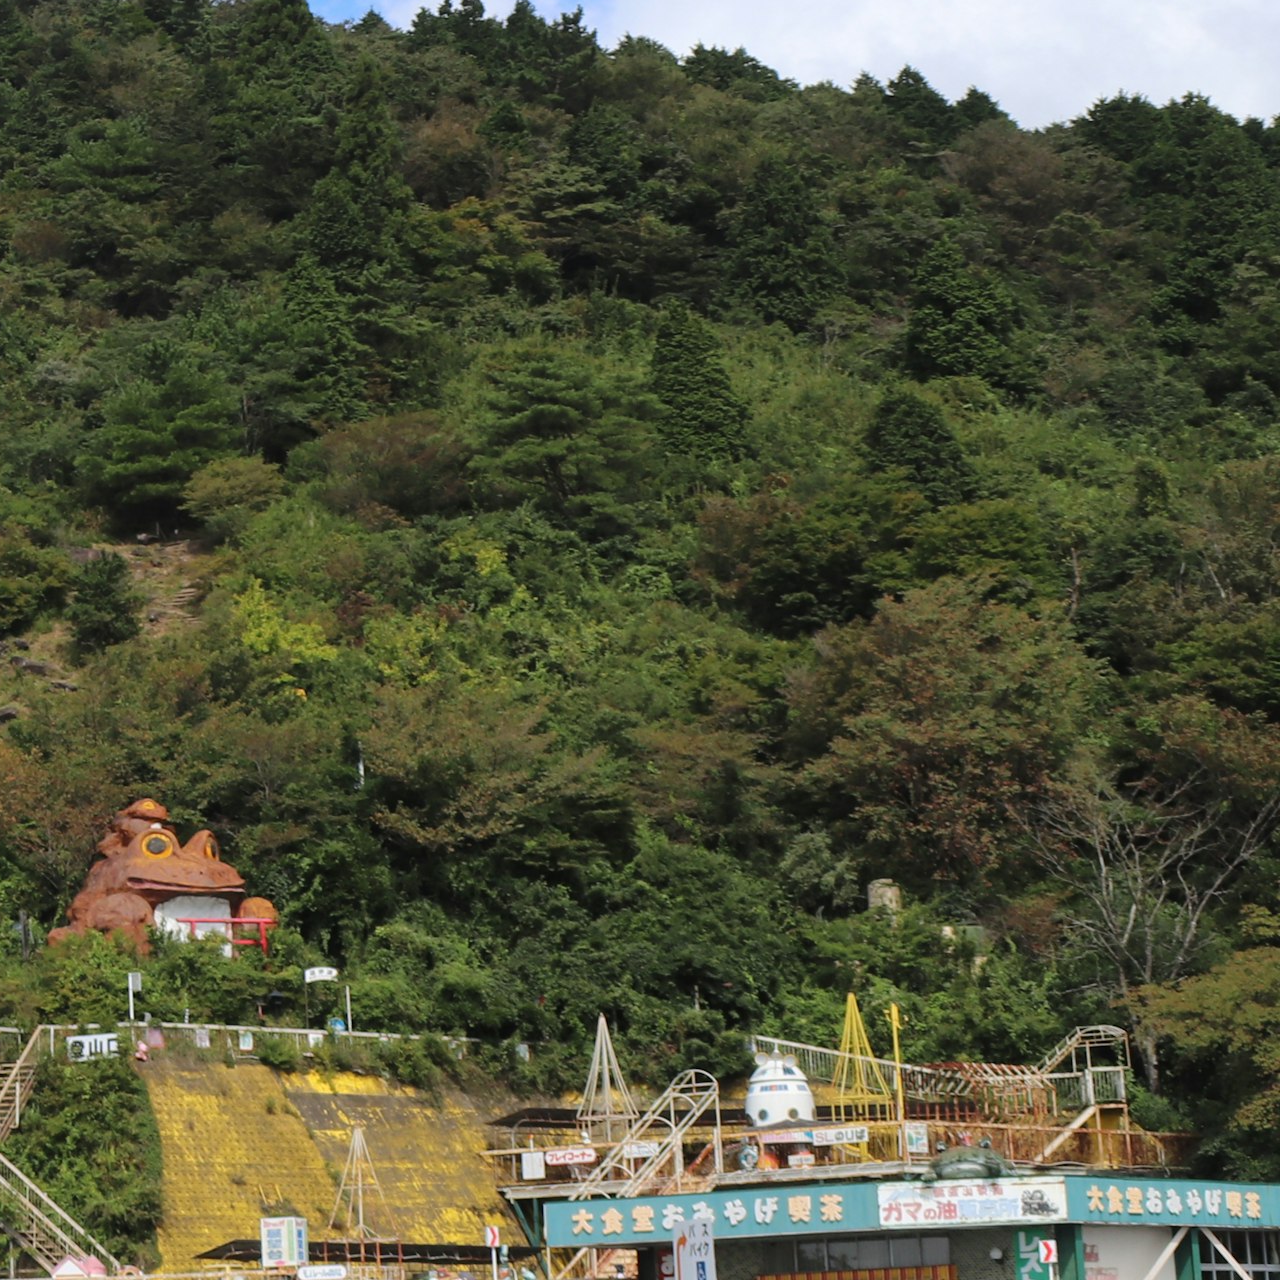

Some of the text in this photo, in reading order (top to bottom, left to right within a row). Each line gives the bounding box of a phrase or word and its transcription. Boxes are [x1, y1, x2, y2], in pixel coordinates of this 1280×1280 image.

[548, 1150, 593, 1162] プレイコーナー
[1086, 1184, 1261, 1218] 大食堂おみやげ喫茶
[571, 1194, 844, 1235] 大食堂おみやげ喫茶
[688, 1223, 709, 1238] バス
[689, 1241, 710, 1256] バイク
